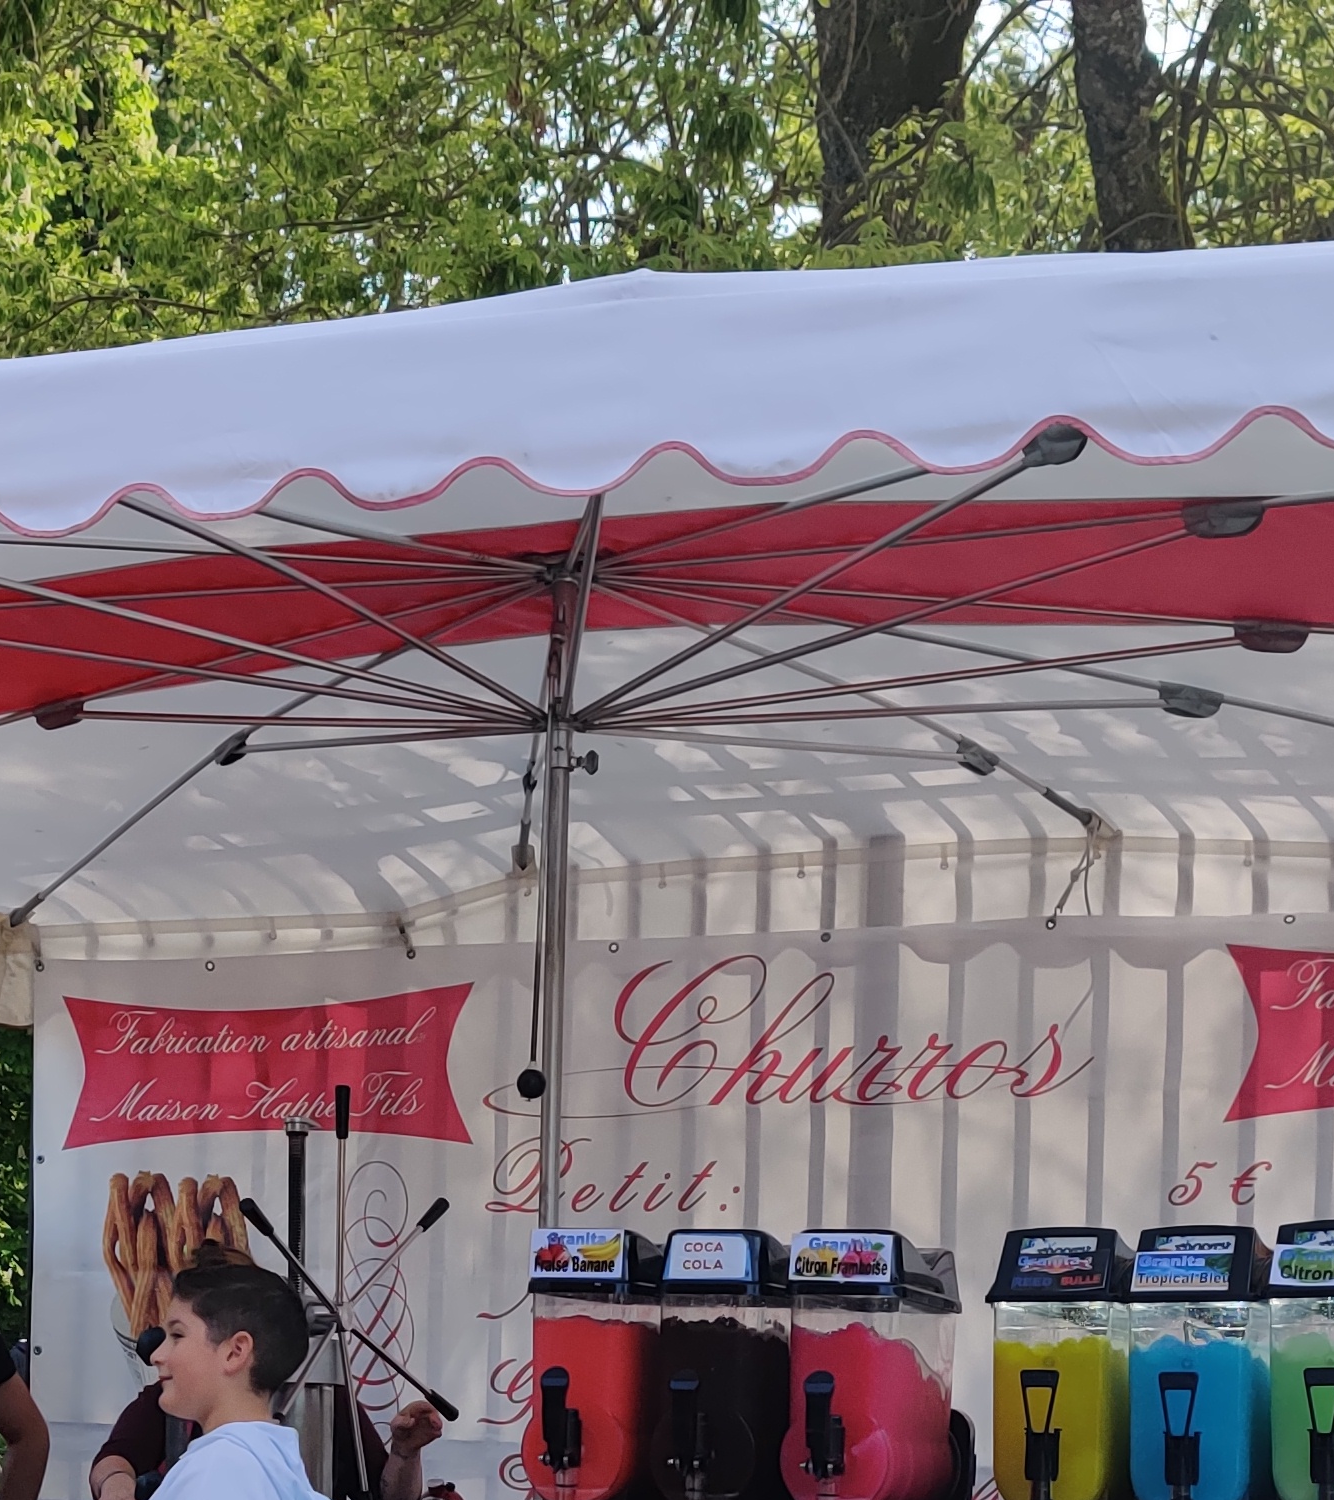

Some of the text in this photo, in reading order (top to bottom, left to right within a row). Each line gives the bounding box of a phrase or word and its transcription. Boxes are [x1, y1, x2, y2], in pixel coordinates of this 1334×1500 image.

[95, 1005, 436, 1055] Fabrication artisanal
[613, 953, 1094, 1107] Churros
[89, 1077, 223, 1122] Maison
[349, 1070, 425, 1117] Fils
[1167, 1160, 1217, 1206] 5
[1228, 1159, 1272, 1206] €
[547, 1231, 607, 1246] Granita
[683, 1241, 724, 1253] COCA
[534, 1255, 615, 1273] Fraise Banane
[682, 1259, 723, 1271] COLA
[795, 1256, 888, 1276] Citron Framboise
[1138, 1255, 1205, 1267] Granita
[1138, 1271, 1229, 1287] Tropical Bleu
[1280, 1265, 1333, 1281] Citron
